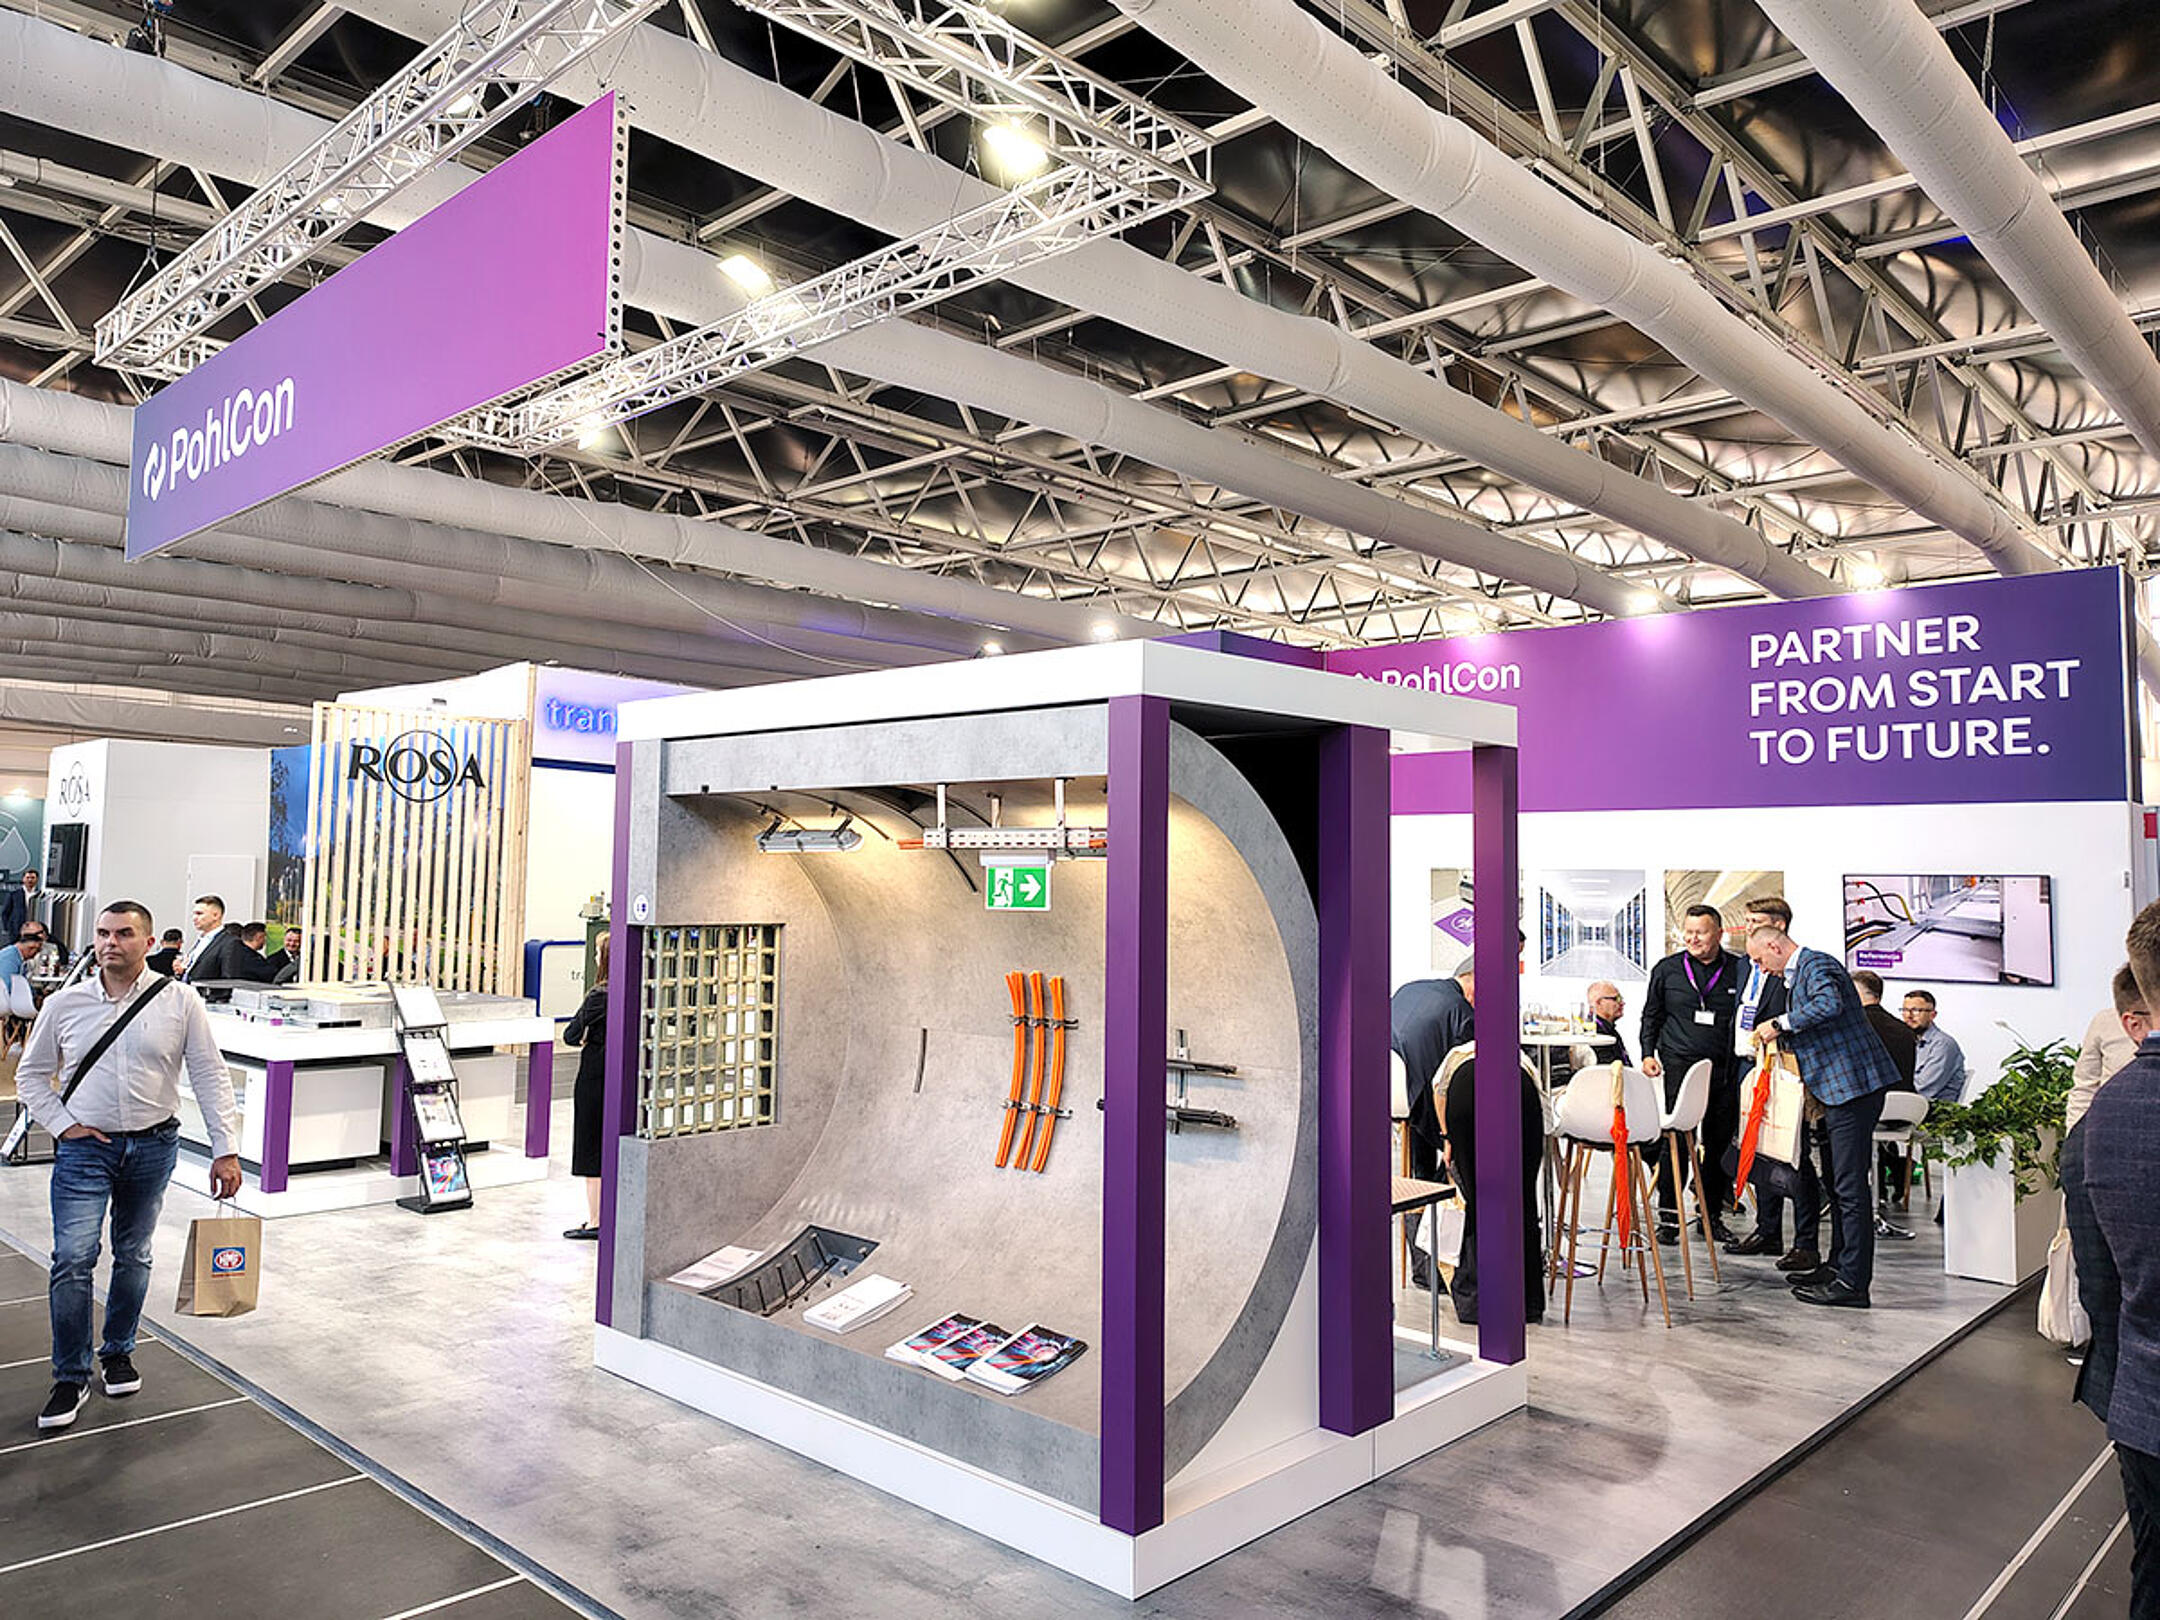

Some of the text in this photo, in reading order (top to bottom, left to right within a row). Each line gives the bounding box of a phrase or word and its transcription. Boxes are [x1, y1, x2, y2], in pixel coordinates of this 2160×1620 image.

[168, 376, 295, 491] PohlCon
[1750, 614, 1981, 669] PARTNER
[1750, 659, 2081, 717] FROM START
[347, 744, 486, 788] ROSA
[1749, 717, 2051, 765] TO FUTURE.
[59, 775, 91, 805] ROSA
